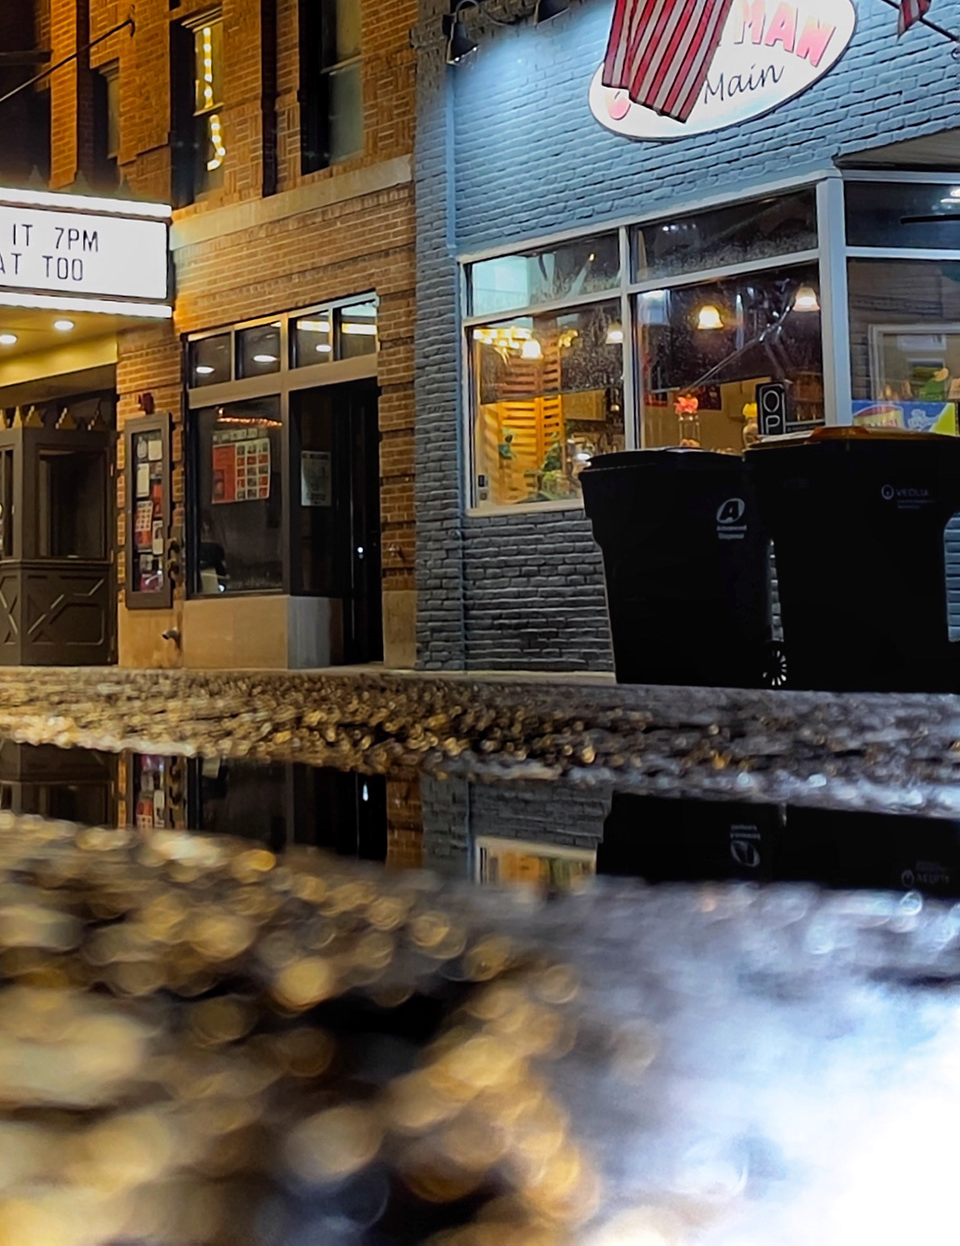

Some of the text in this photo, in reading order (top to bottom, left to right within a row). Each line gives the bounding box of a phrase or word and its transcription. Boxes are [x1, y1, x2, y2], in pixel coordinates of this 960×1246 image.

[703, 63, 784, 104] Main
[13, 223, 33, 247] IT
[54, 226, 100, 252] 7PM
[42, 254, 84, 281] TOO
